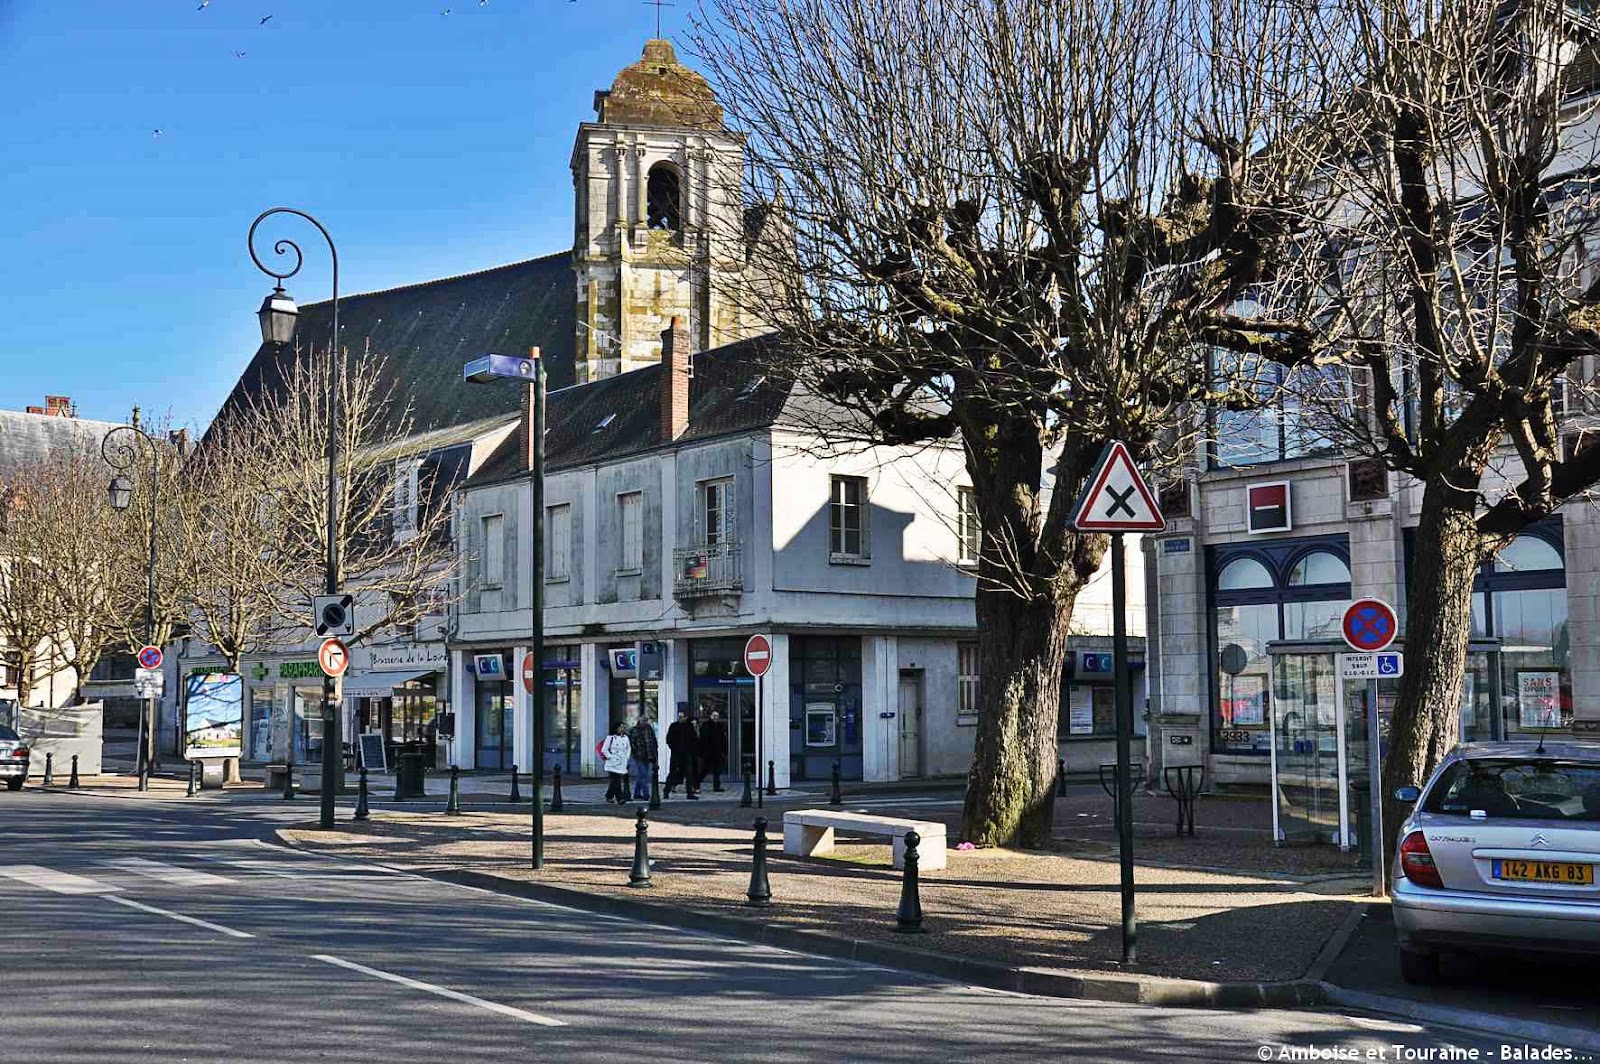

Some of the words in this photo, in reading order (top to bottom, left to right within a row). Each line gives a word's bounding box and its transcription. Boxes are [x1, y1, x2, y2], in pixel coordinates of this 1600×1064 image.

[407, 650, 414, 662] de
[417, 651, 423, 662] la
[427, 650, 449, 662] Loire
[1524, 678, 1552, 687] SANS
[1222, 731, 1250, 742] 3933
[1505, 862, 1528, 877] 142
[1535, 864, 1560, 878] AKG
[1567, 865, 1584, 880] 83
